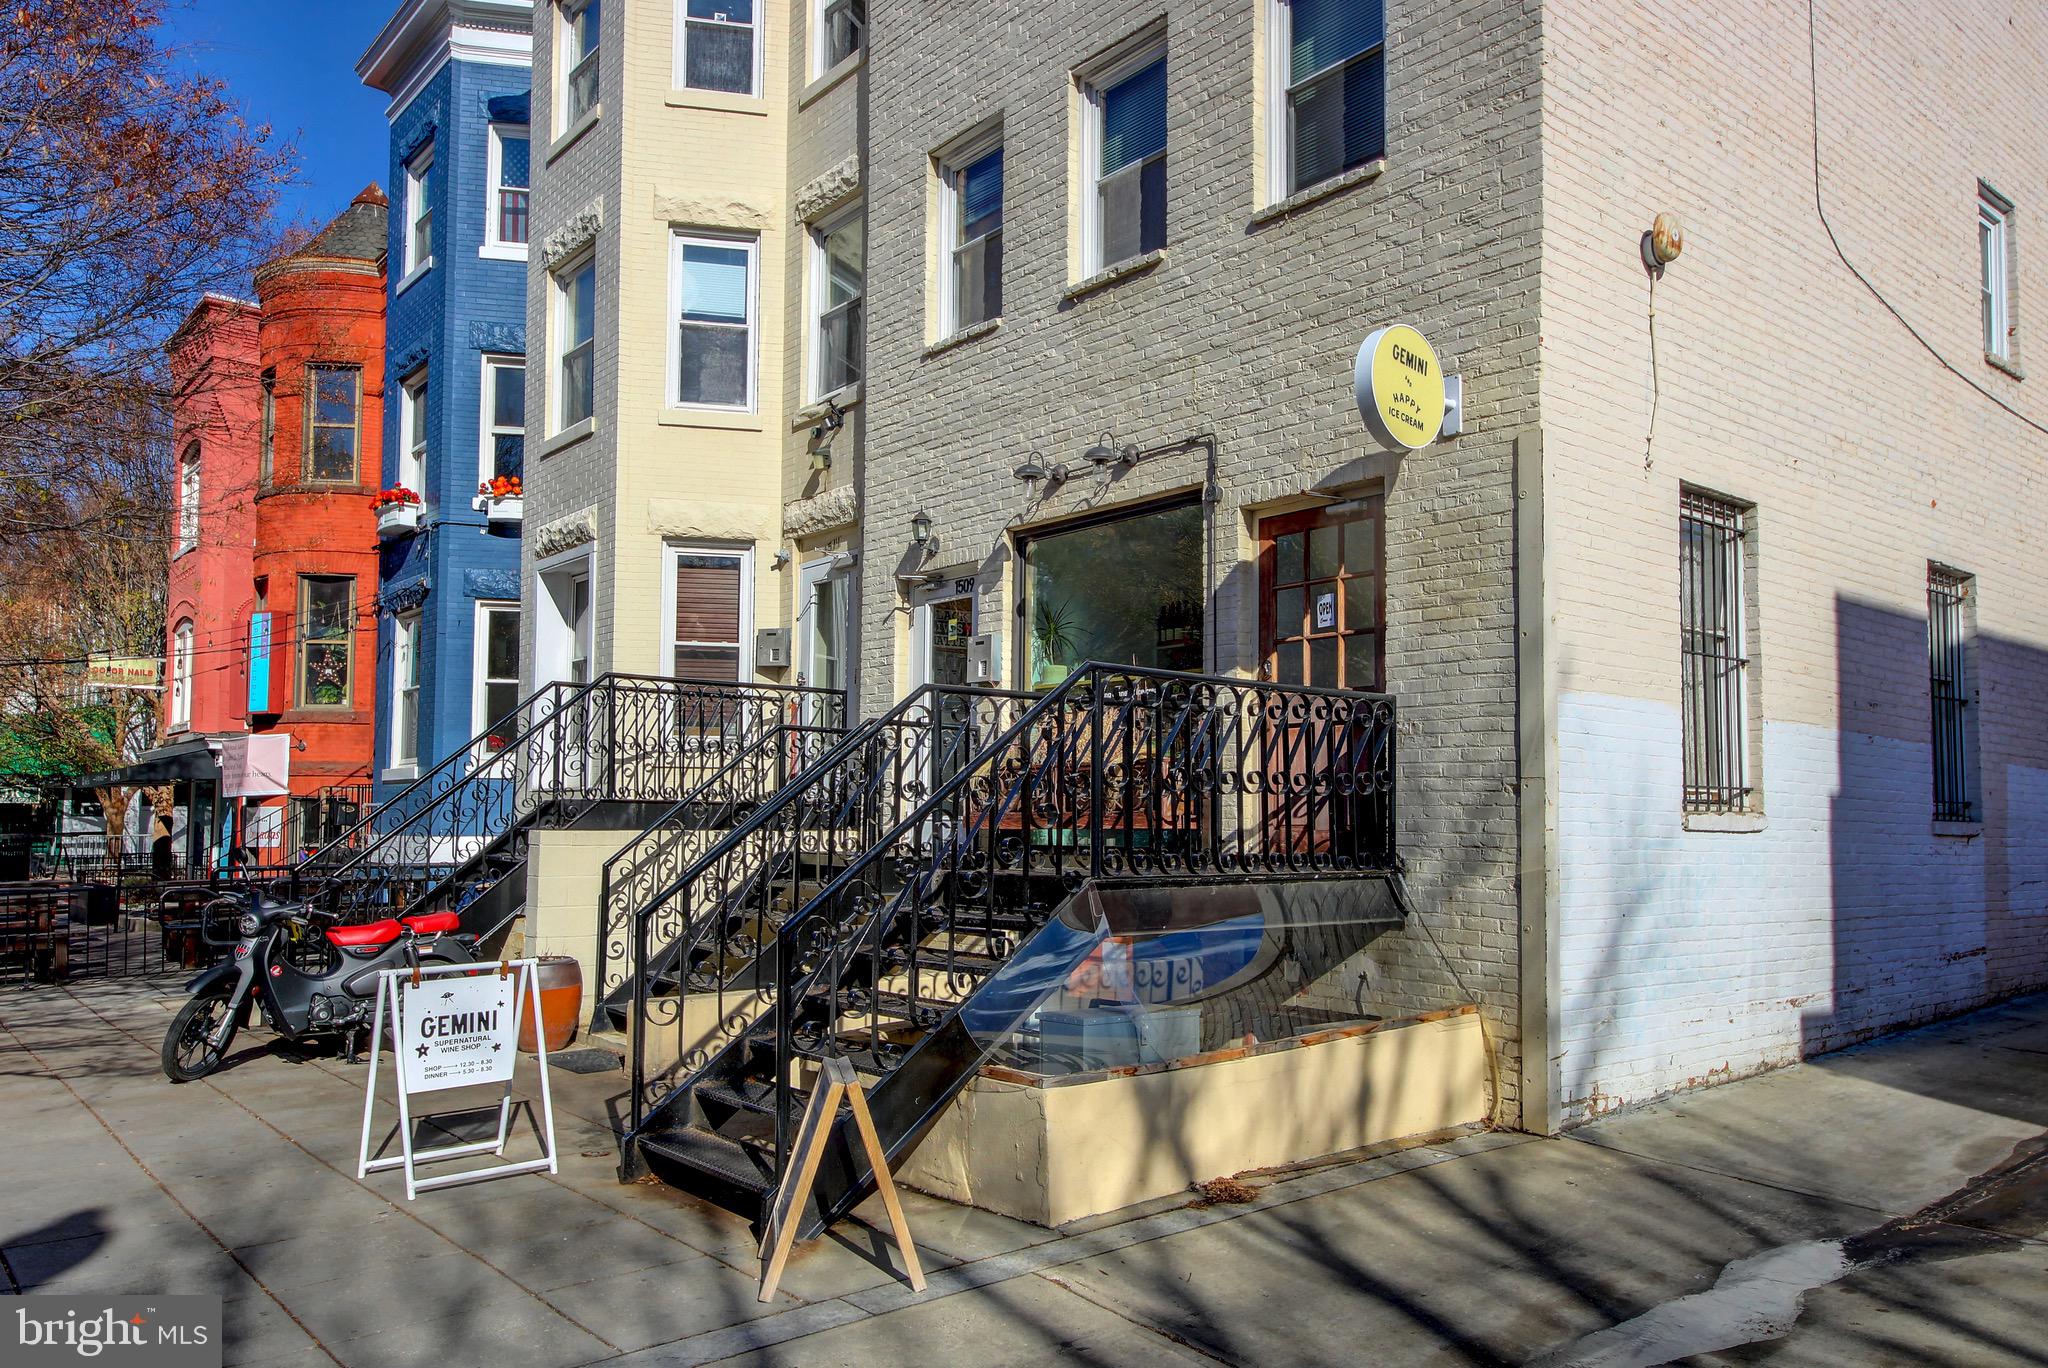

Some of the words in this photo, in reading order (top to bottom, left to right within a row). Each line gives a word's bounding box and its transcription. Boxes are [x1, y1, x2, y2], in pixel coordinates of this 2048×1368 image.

[1392, 344, 1428, 377] GEMINI
[1393, 392, 1421, 414] HAPPY
[1388, 406, 1400, 419] ICE
[1400, 414, 1424, 431] CREAM
[955, 577, 975, 595] 1509
[1318, 601, 1333, 616] OPEN
[421, 1010, 498, 1039] GEMINI
[434, 1035, 491, 1048] SUPERNATURAL
[440, 1045, 460, 1053] WINE
[461, 1043, 481, 1052] SHOP
[424, 1065, 442, 1073] SHOP
[424, 1071, 448, 1080] DINNER
